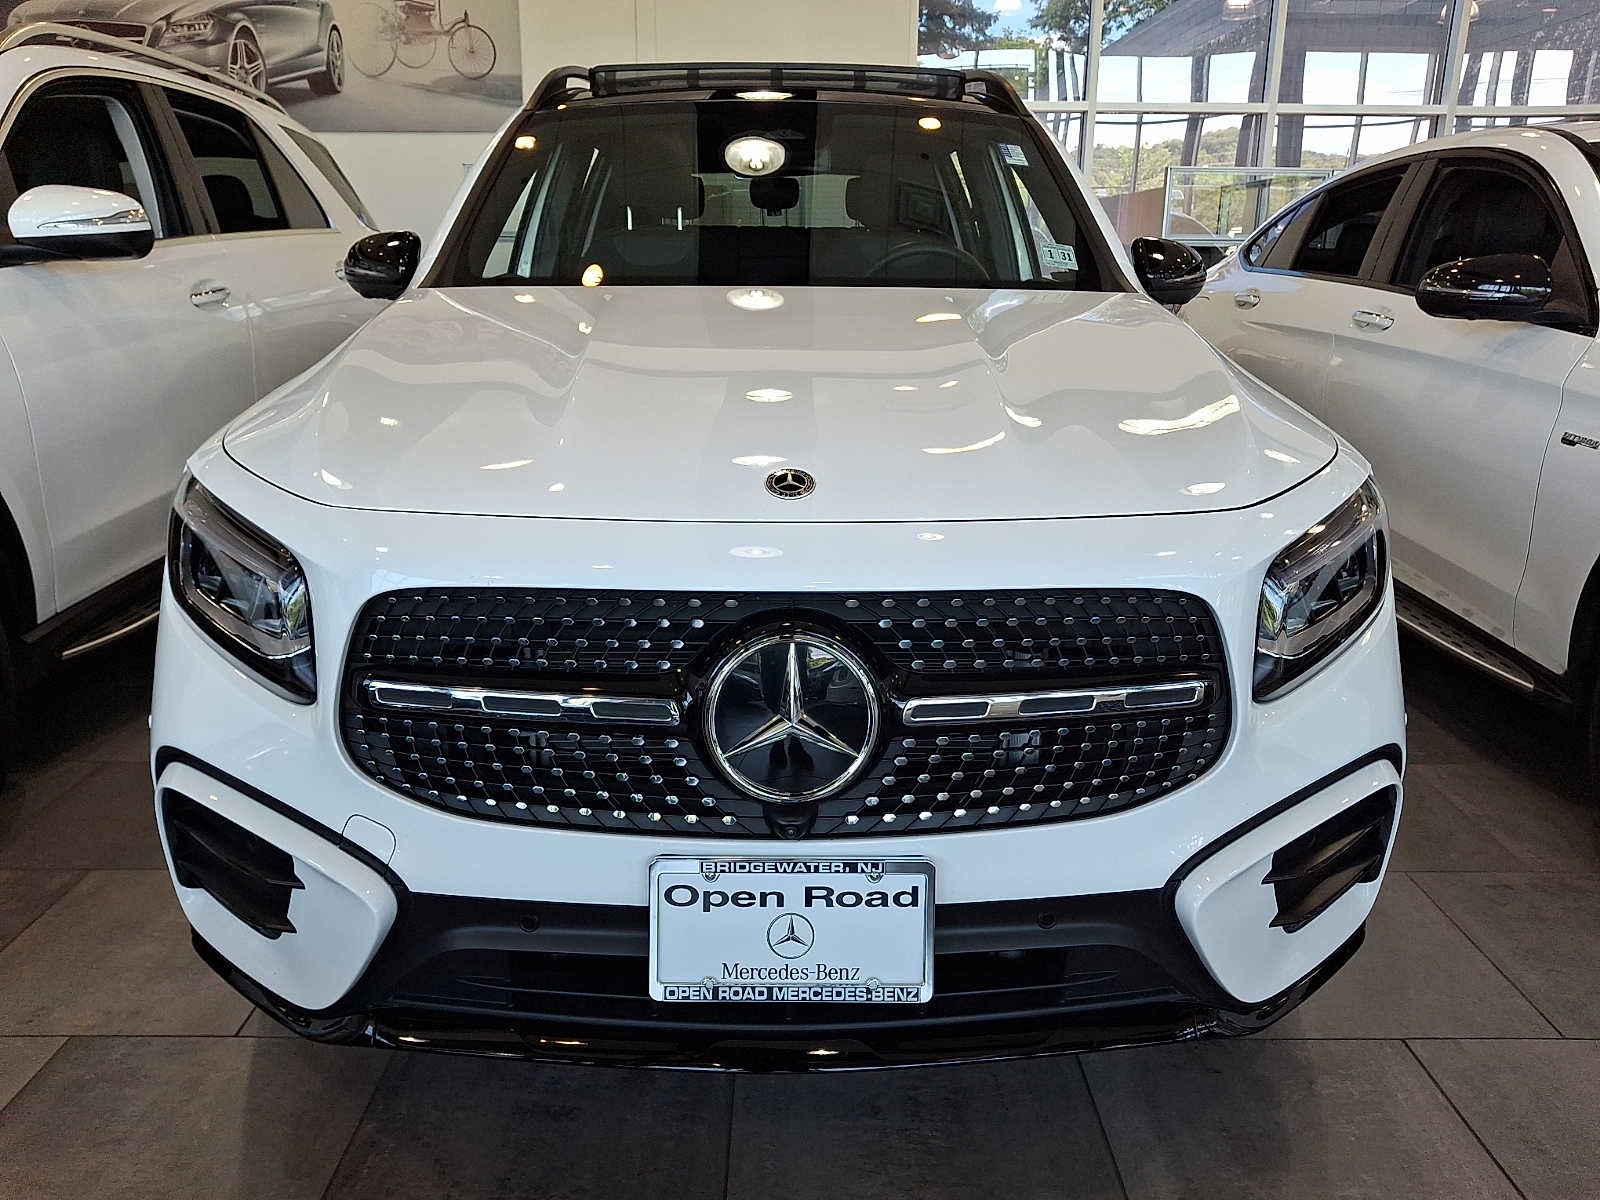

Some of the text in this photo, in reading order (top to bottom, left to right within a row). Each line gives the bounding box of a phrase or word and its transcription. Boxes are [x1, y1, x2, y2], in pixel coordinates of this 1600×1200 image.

[1047, 249, 1073, 262] 1 31
[702, 862, 884, 874] BRIDGEWATER, NJ
[664, 884, 919, 912] Open Road
[721, 963, 860, 981] Mercedes-Benz
[665, 987, 919, 1001] OPEN ROAD MERCEDES-BENZ
